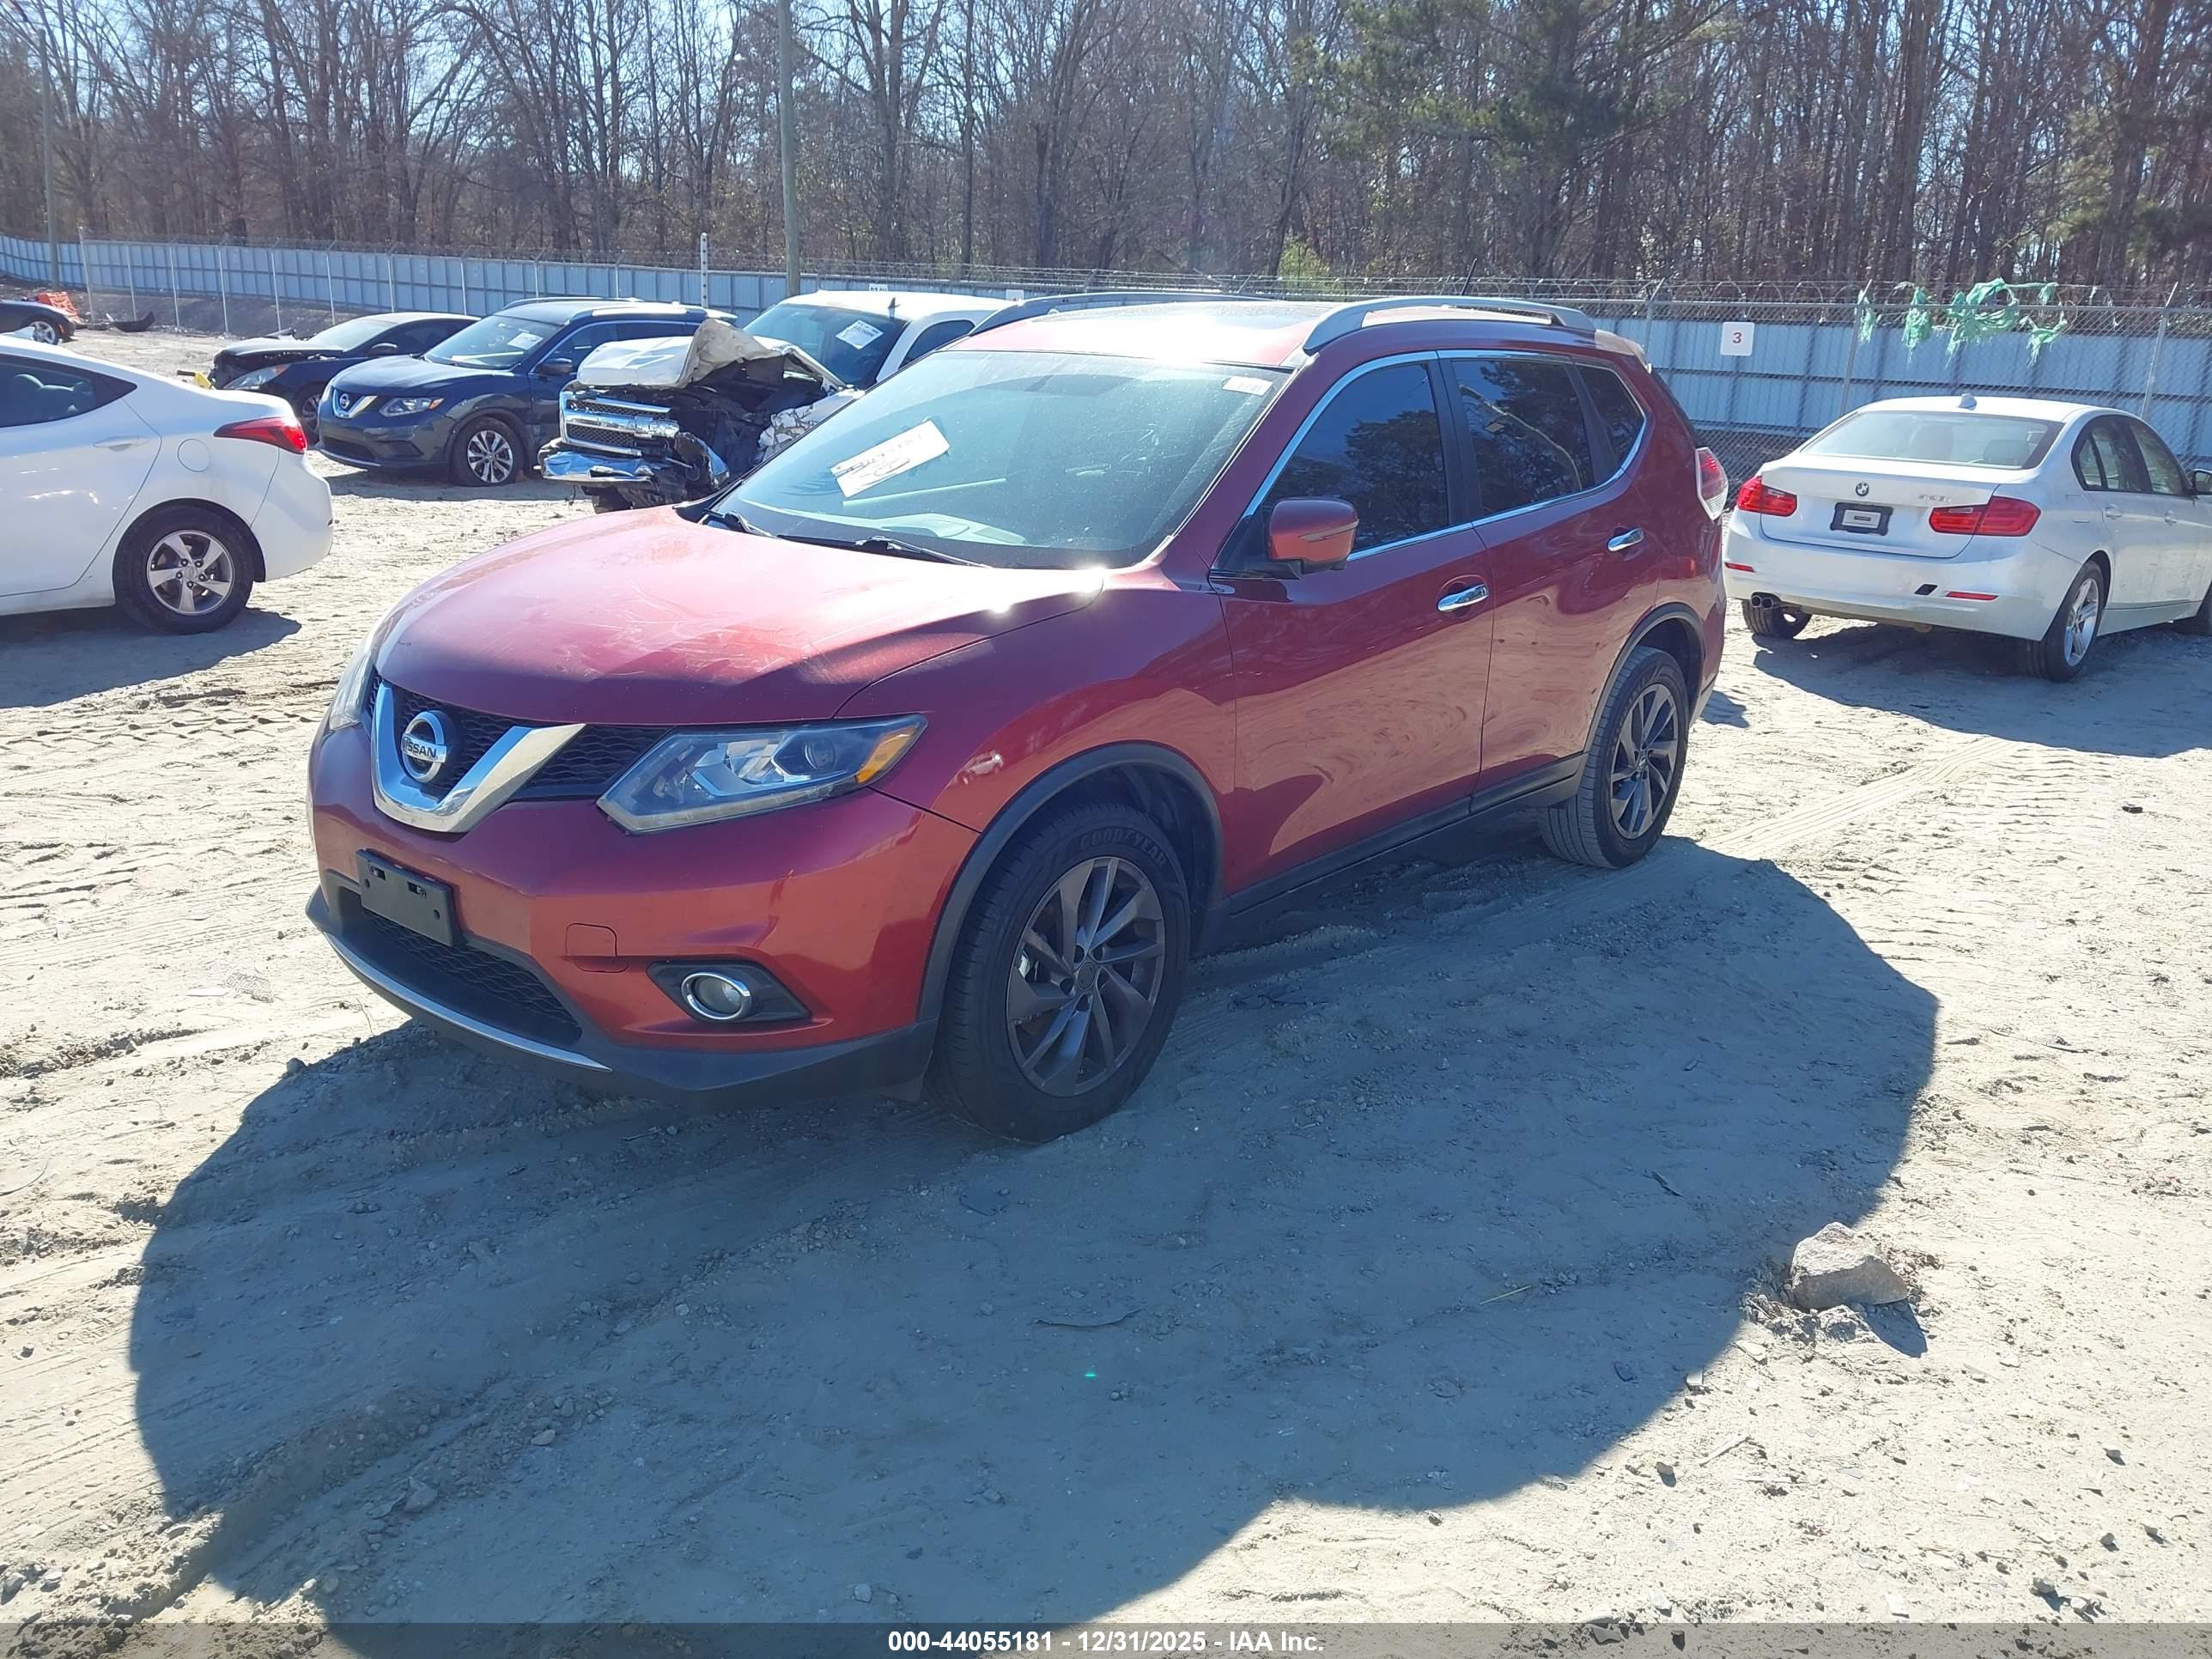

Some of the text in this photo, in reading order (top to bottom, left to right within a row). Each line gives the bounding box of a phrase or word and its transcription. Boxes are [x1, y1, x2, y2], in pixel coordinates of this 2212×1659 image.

[1732, 331, 1742, 344] 3
[402, 735, 437, 758] NISSAN
[1079, 828, 1167, 866] GOODYEAR
